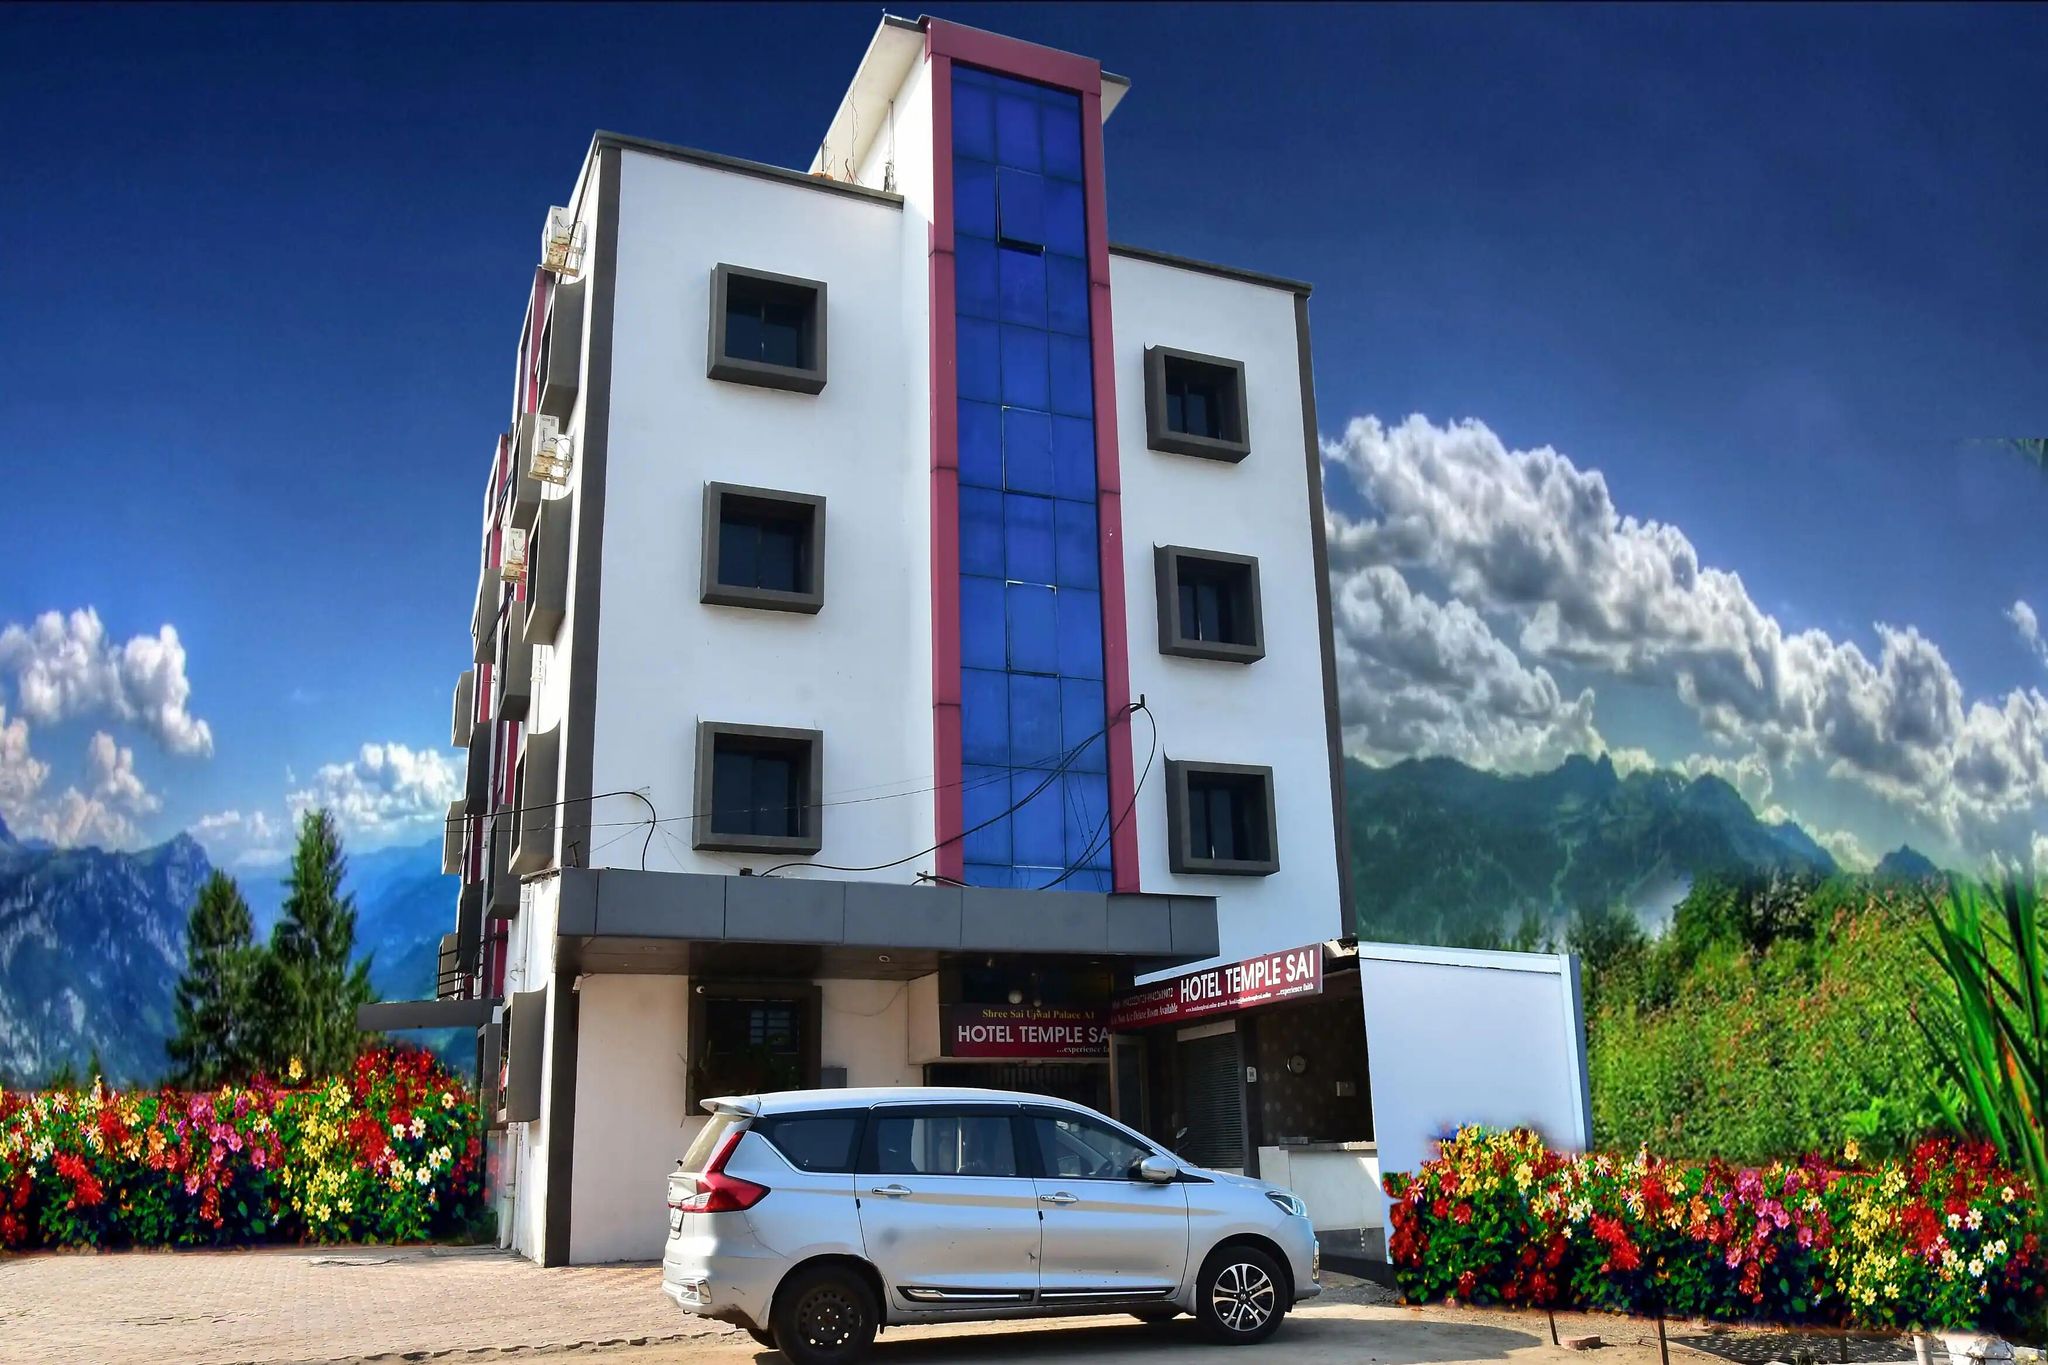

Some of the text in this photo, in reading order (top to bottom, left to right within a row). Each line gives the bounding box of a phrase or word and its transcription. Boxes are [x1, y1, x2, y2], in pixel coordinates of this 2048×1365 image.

[1180, 971, 1222, 1003] HOTEL
[1225, 957, 1281, 994] TEMPLE
[1285, 949, 1314, 983] SAI
[982, 1008, 1008, 1018] Shree
[1010, 1009, 1024, 1018] Sai
[1053, 1010, 1081, 1020] Palace
[958, 1025, 1110, 1043] HOTEL TEMPLE SA
